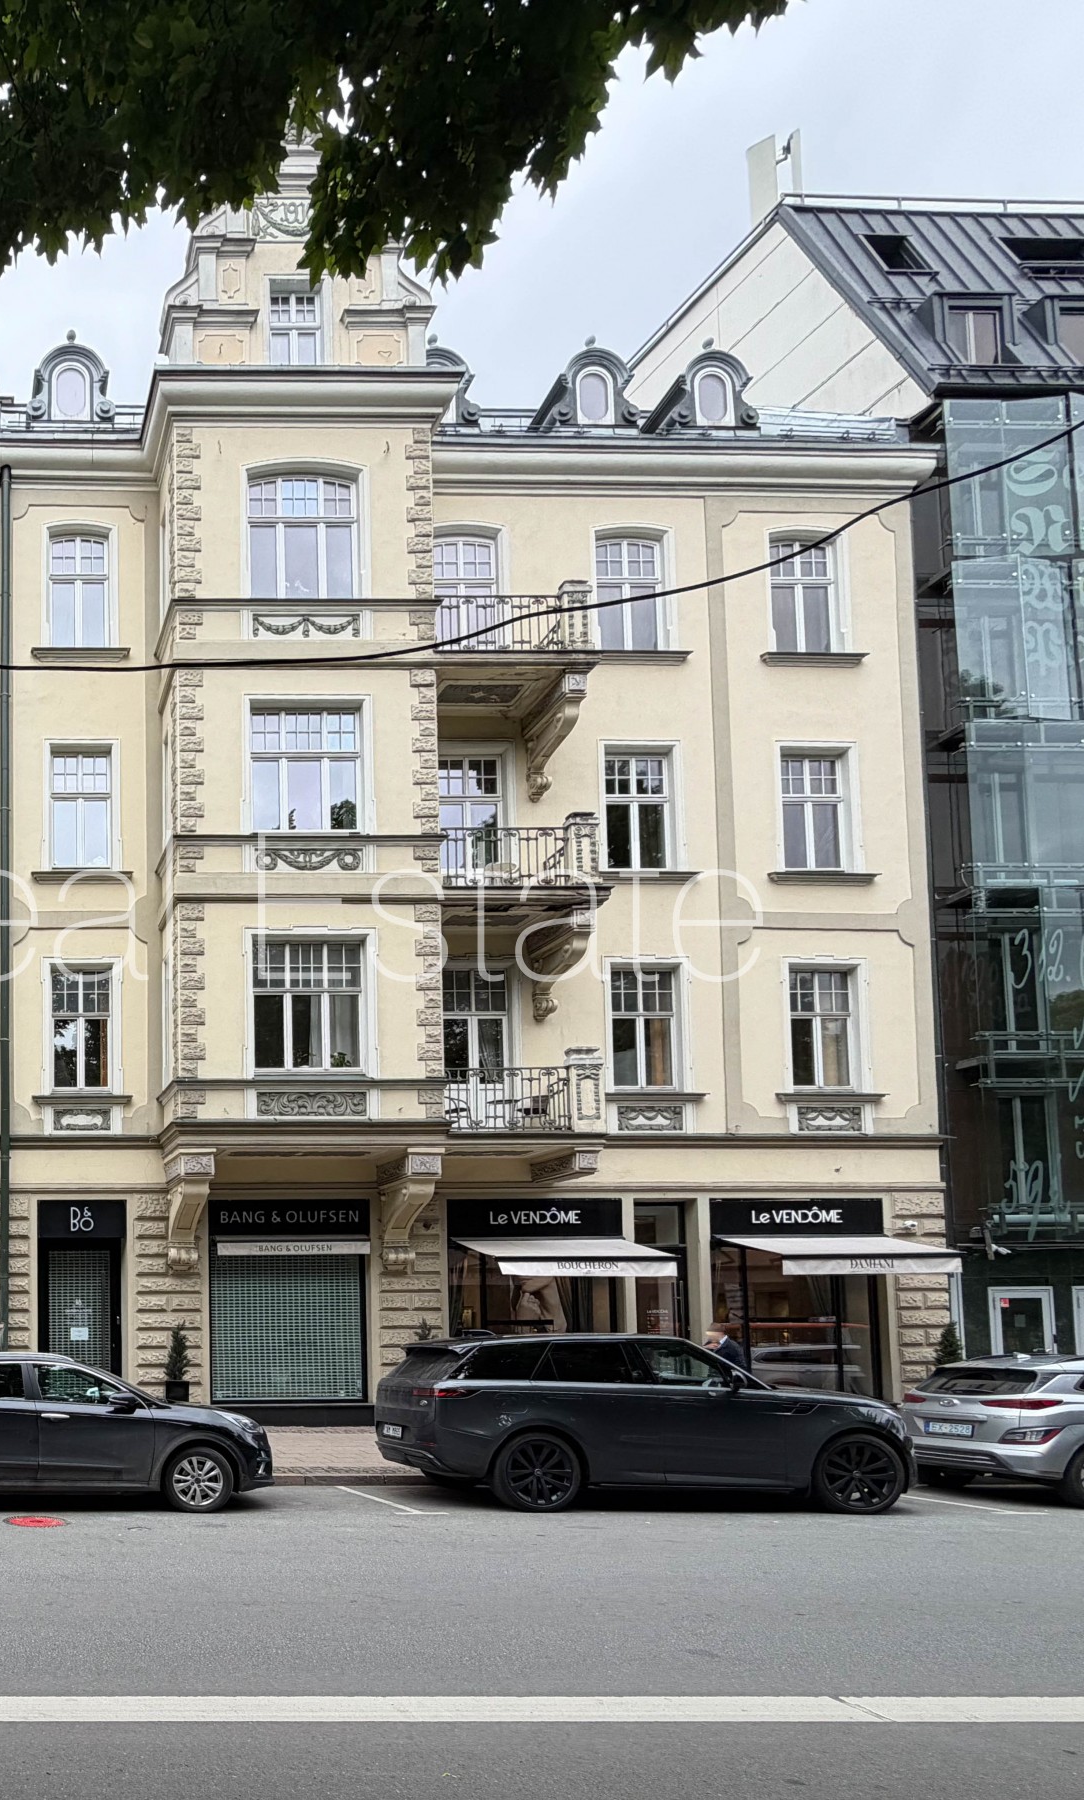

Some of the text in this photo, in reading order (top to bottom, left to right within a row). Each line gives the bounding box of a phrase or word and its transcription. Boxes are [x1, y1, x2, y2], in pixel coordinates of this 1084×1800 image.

[220, 1210, 359, 1223] BANG & OLUFSEN
[489, 1207, 581, 1224] Le VENDÔME
[751, 1206, 843, 1224] Le VENDÔME
[557, 1261, 619, 1269] BOUCHERON
